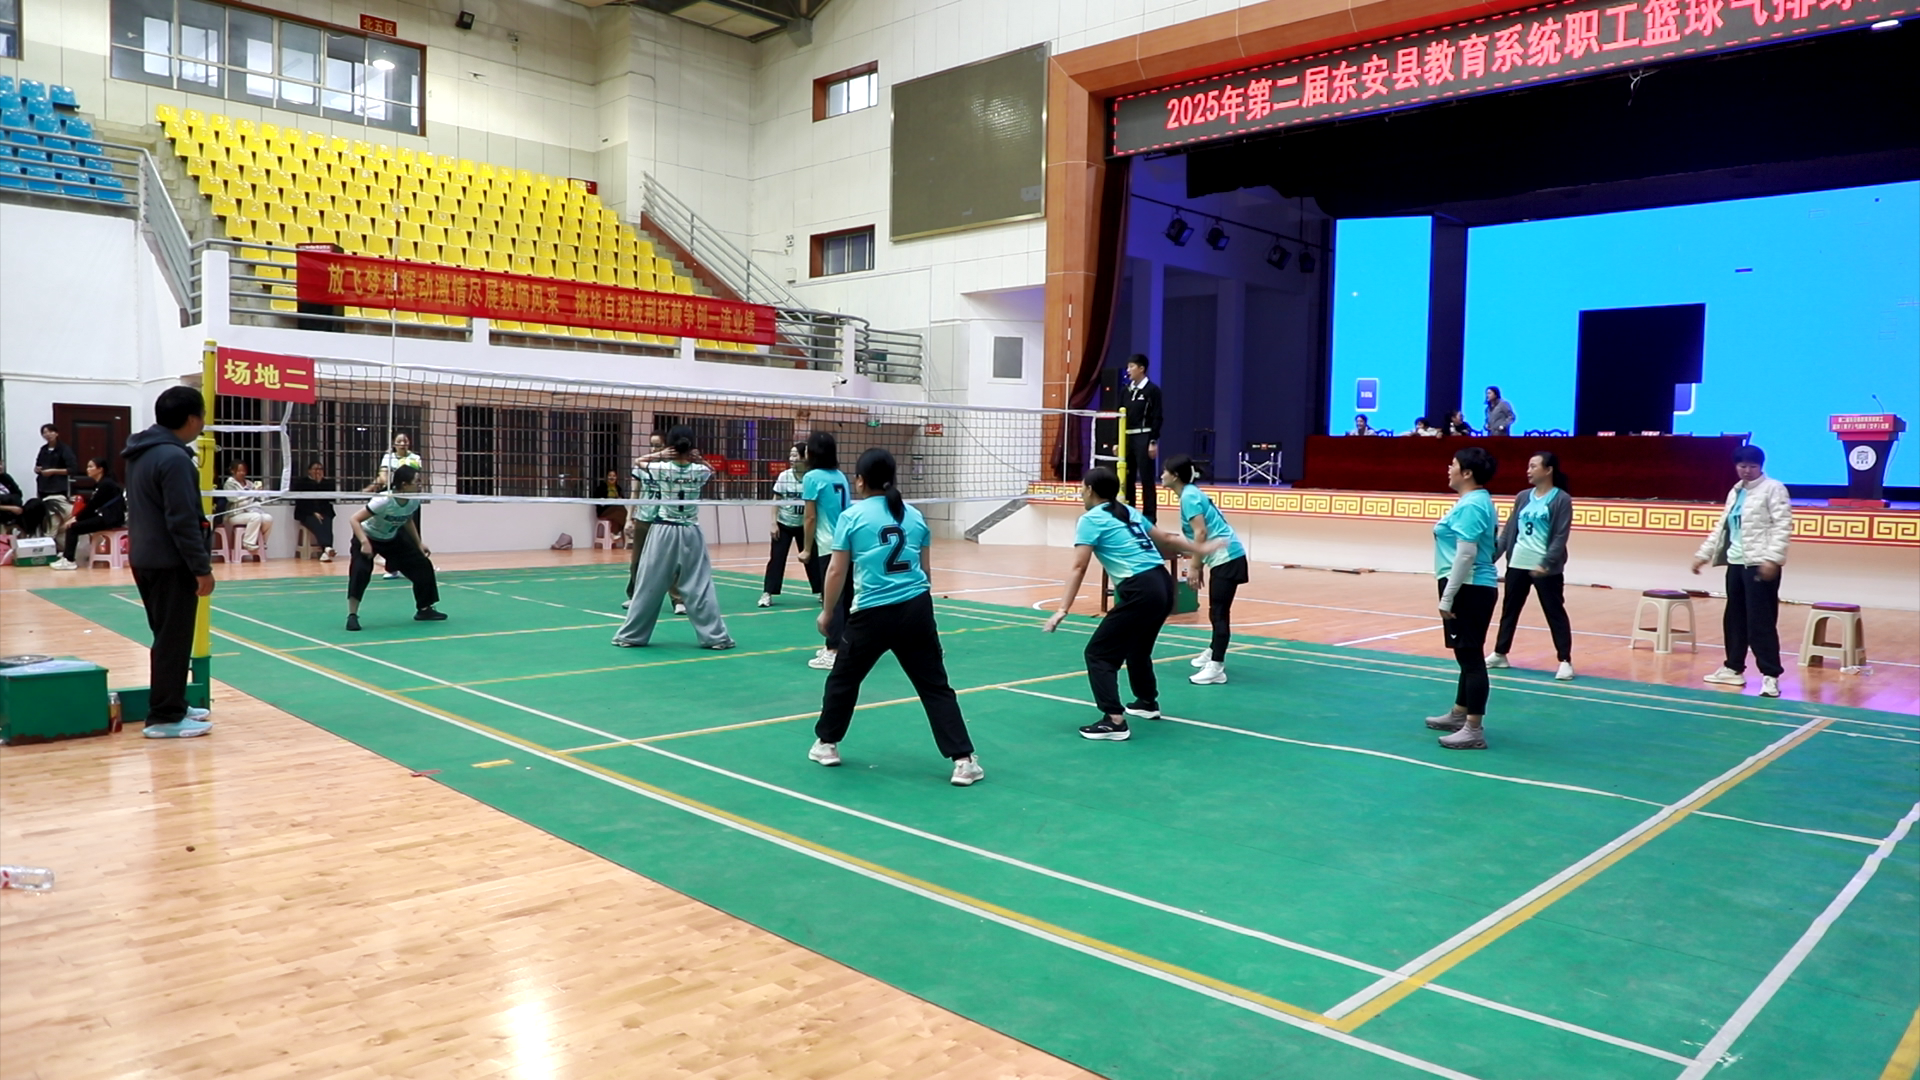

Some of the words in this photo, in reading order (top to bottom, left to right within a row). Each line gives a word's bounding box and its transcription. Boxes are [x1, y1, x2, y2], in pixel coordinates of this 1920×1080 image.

[363, 17, 394, 35] 北五区
[327, 262, 559, 315] 放飞梦想挥动激情尽展教师风采
[575, 289, 755, 337] 挑战自我披荆斩棘争创一流业绩
[223, 358, 309, 390] 场地二
[832, 483, 846, 511] 7
[1525, 521, 1534, 536] 3
[878, 524, 912, 575] 2
